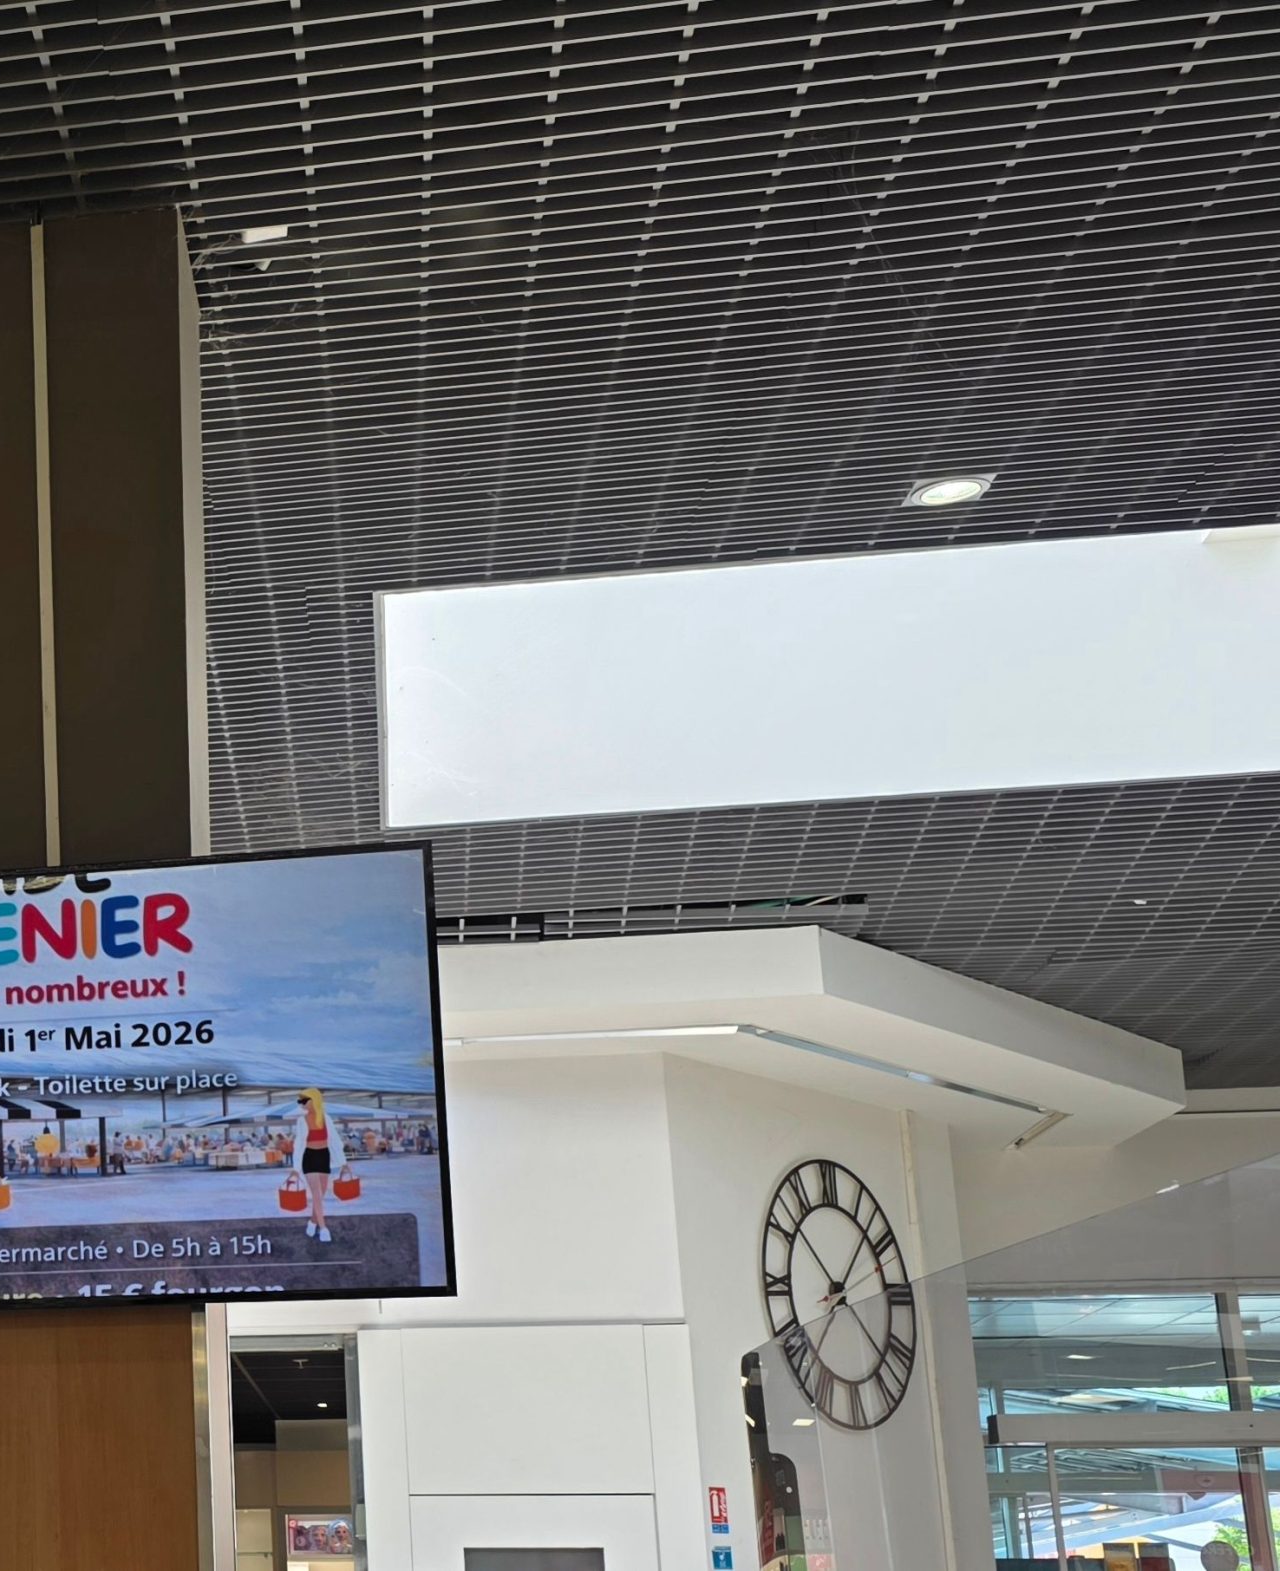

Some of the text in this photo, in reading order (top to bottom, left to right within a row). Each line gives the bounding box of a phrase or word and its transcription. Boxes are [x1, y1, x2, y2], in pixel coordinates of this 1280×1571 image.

[5, 974, 168, 1005] nombreux
[177, 971, 186, 996] !
[24, 1026, 56, 1052] 1er
[65, 1023, 121, 1050] Mai
[131, 1020, 215, 1047] 2026
[33, 1074, 127, 1096] Toilette
[133, 1076, 170, 1092] sur
[176, 1069, 238, 1094] place
[133, 1239, 165, 1258] De
[172, 1237, 201, 1257] 5h
[208, 1235, 221, 1256] à
[229, 1235, 271, 1255] 15h
